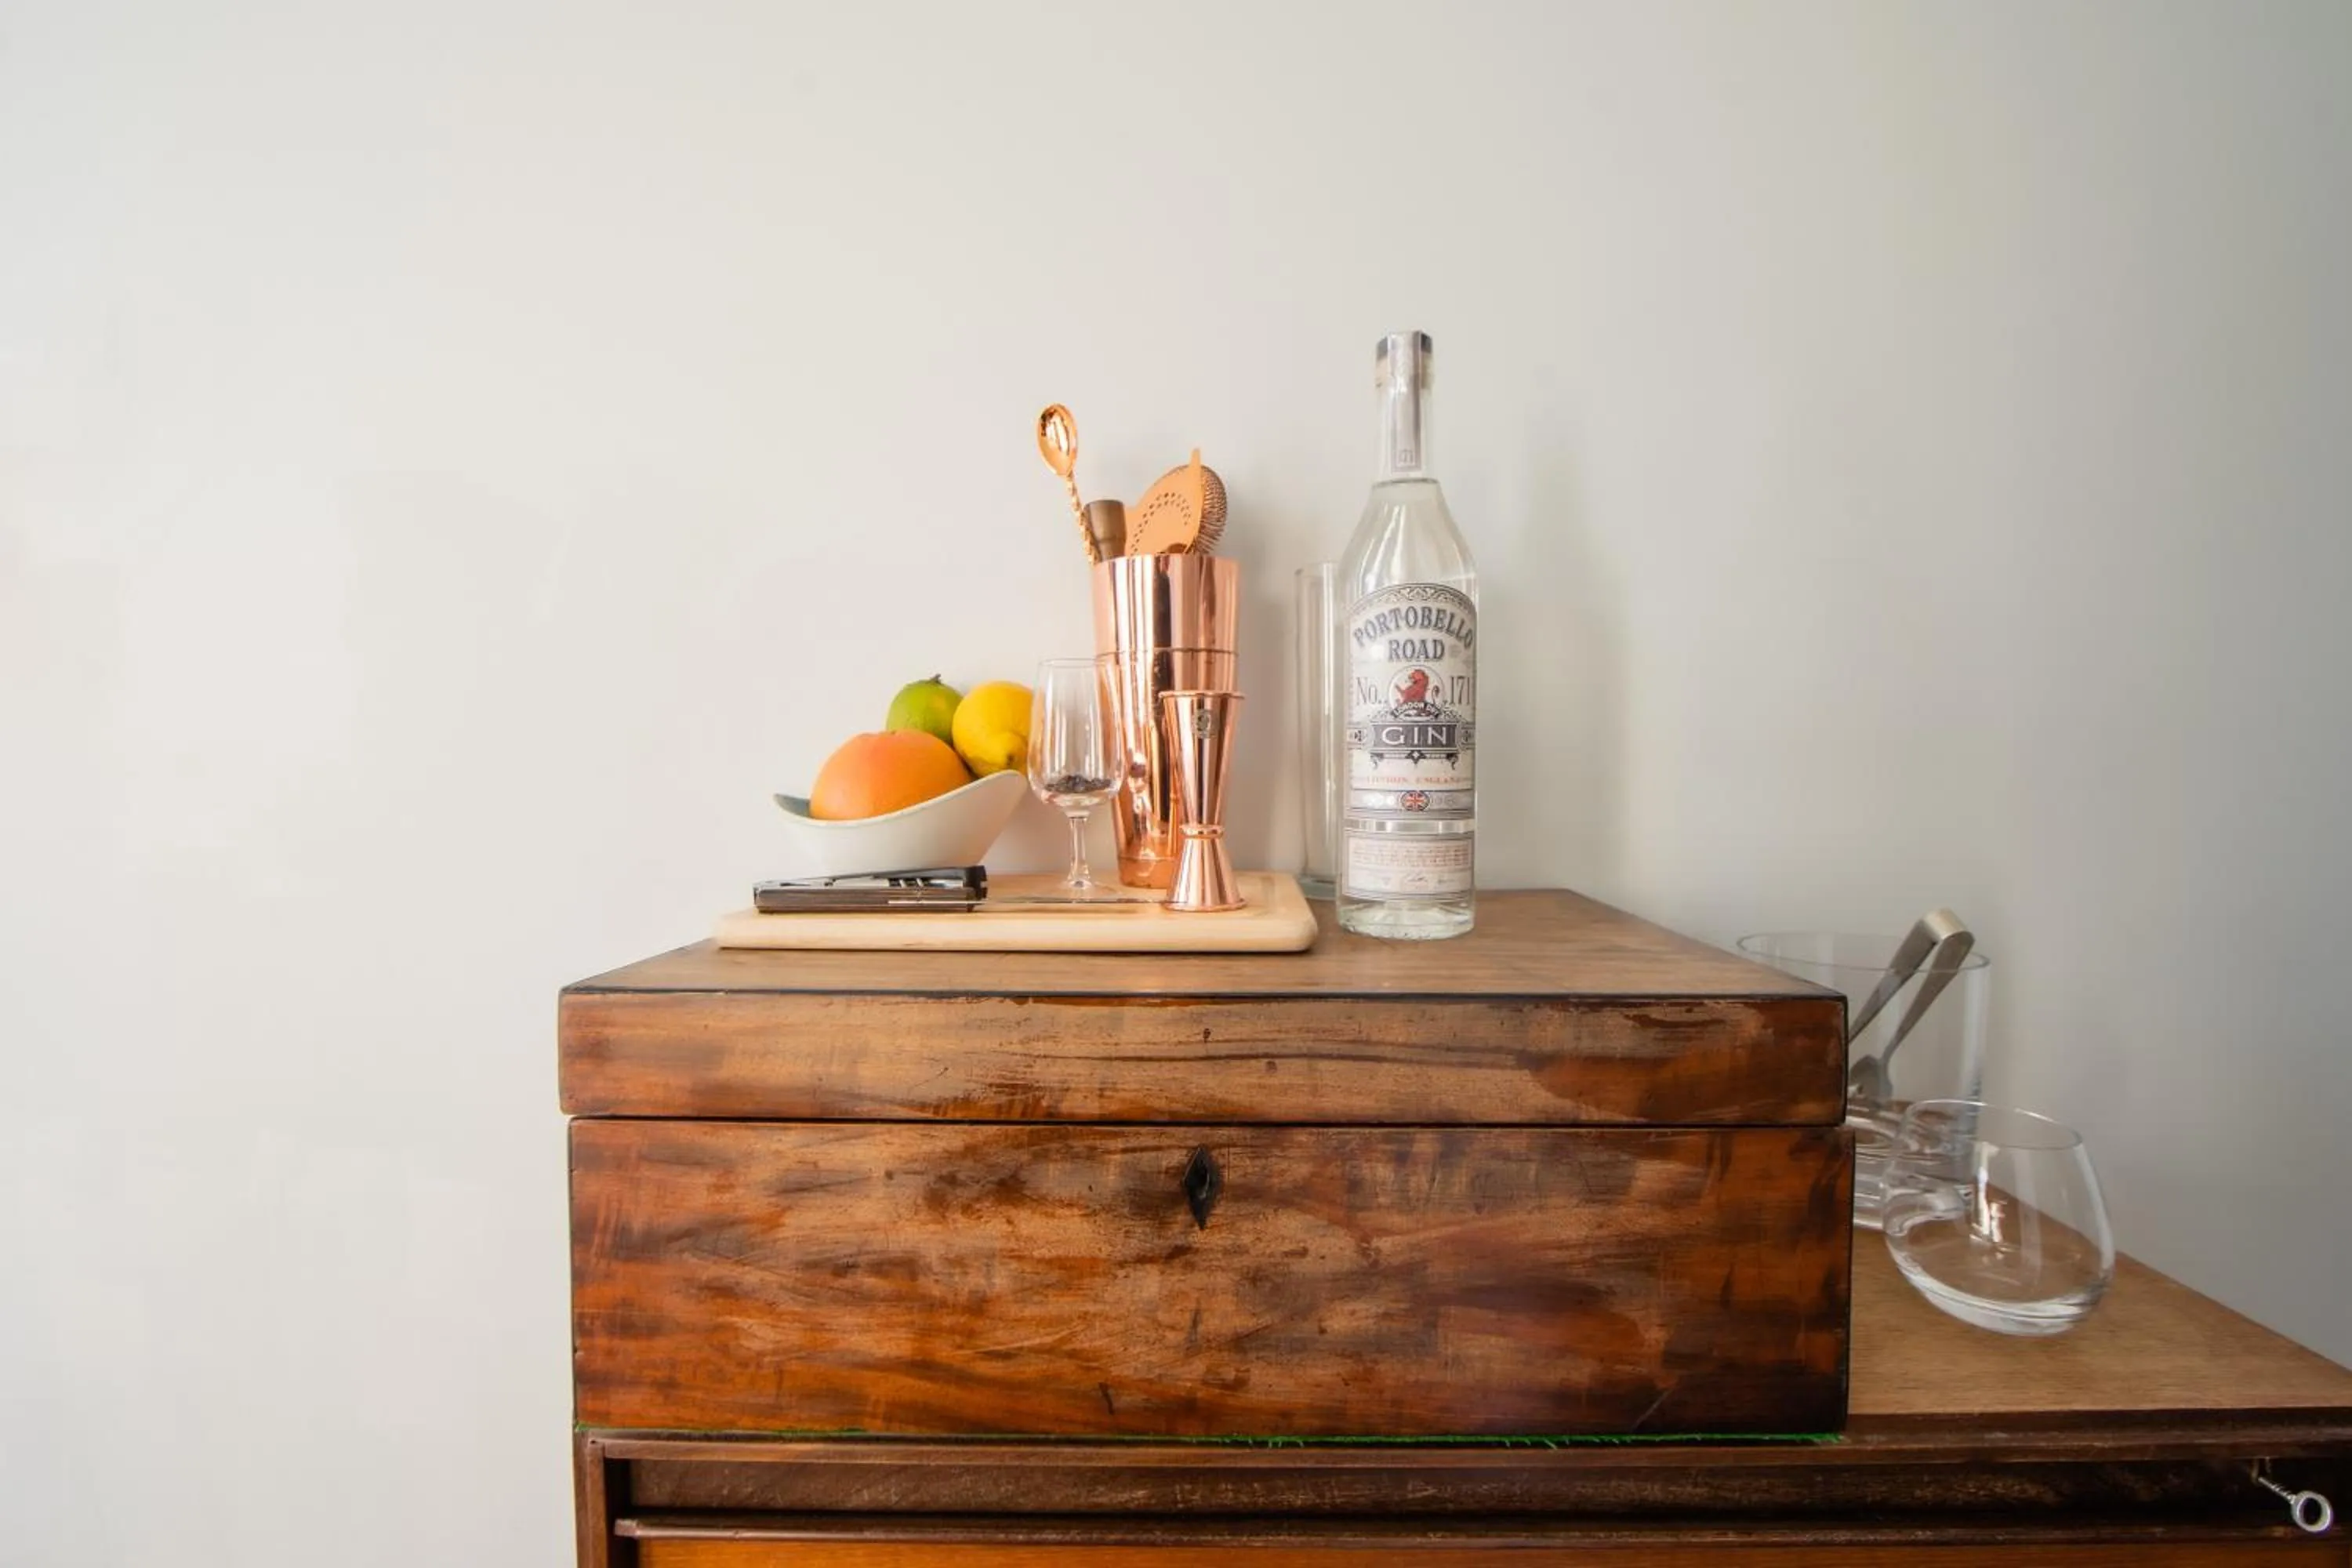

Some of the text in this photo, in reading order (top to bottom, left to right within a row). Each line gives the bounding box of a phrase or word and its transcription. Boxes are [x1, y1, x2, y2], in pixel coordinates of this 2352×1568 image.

[1354, 606, 1473, 649] PORTOBELLO
[1388, 639, 1445, 662] ROAD
[1382, 726, 1448, 746] GIN
